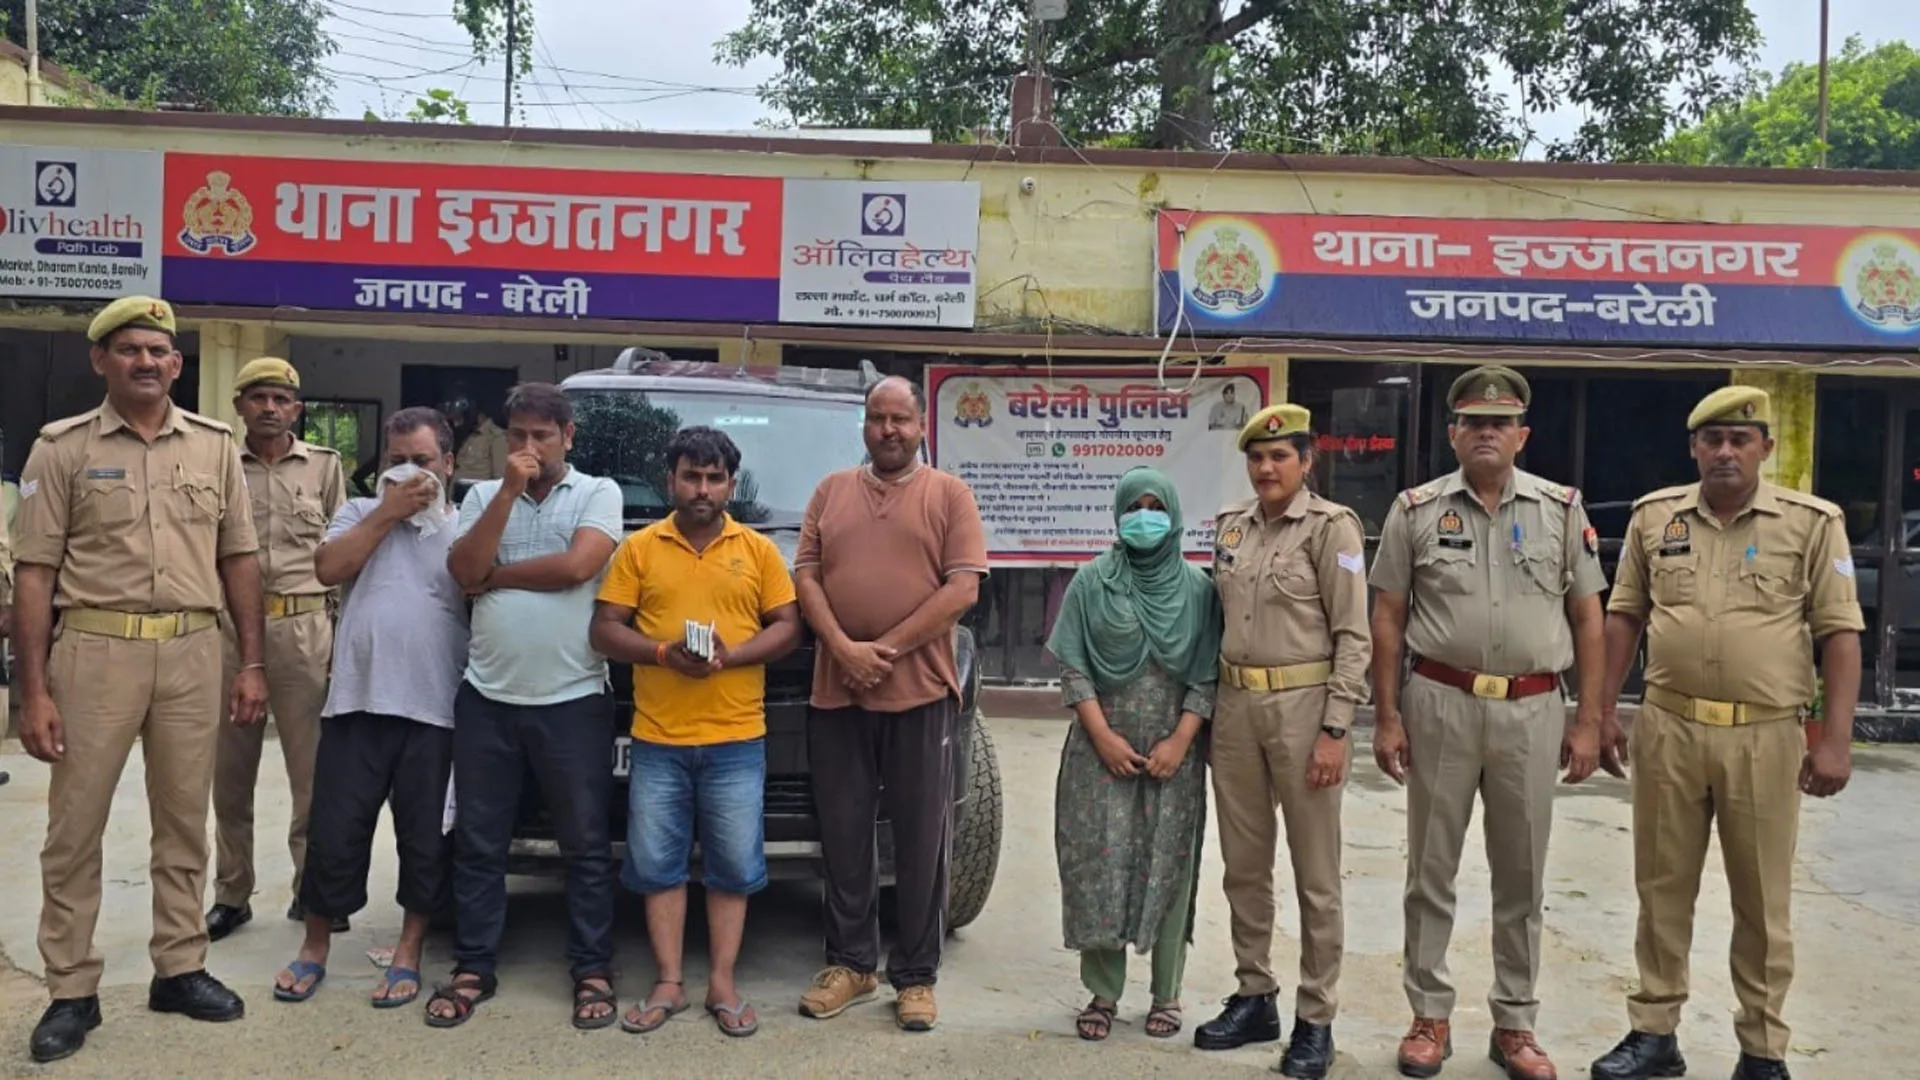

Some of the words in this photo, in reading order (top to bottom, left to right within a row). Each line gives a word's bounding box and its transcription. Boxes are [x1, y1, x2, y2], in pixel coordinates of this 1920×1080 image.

[0, 204, 143, 239] livhealth
[275, 182, 421, 243] थाना
[436, 188, 751, 256] इज्जतनगर
[57, 241, 88, 254] Path
[92, 243, 119, 255] Lab
[793, 239, 972, 269] ऑलिवहेल्थ
[1488, 235, 1803, 277] इज्जतनगर
[37, 260, 76, 274] Dharam
[353, 278, 466, 309] जनपद
[501, 274, 591, 316] बरेली
[1006, 383, 1091, 419] बरेली
[1096, 383, 1193, 428] पुलिस
[1073, 443, 1165, 458] 9917020009
